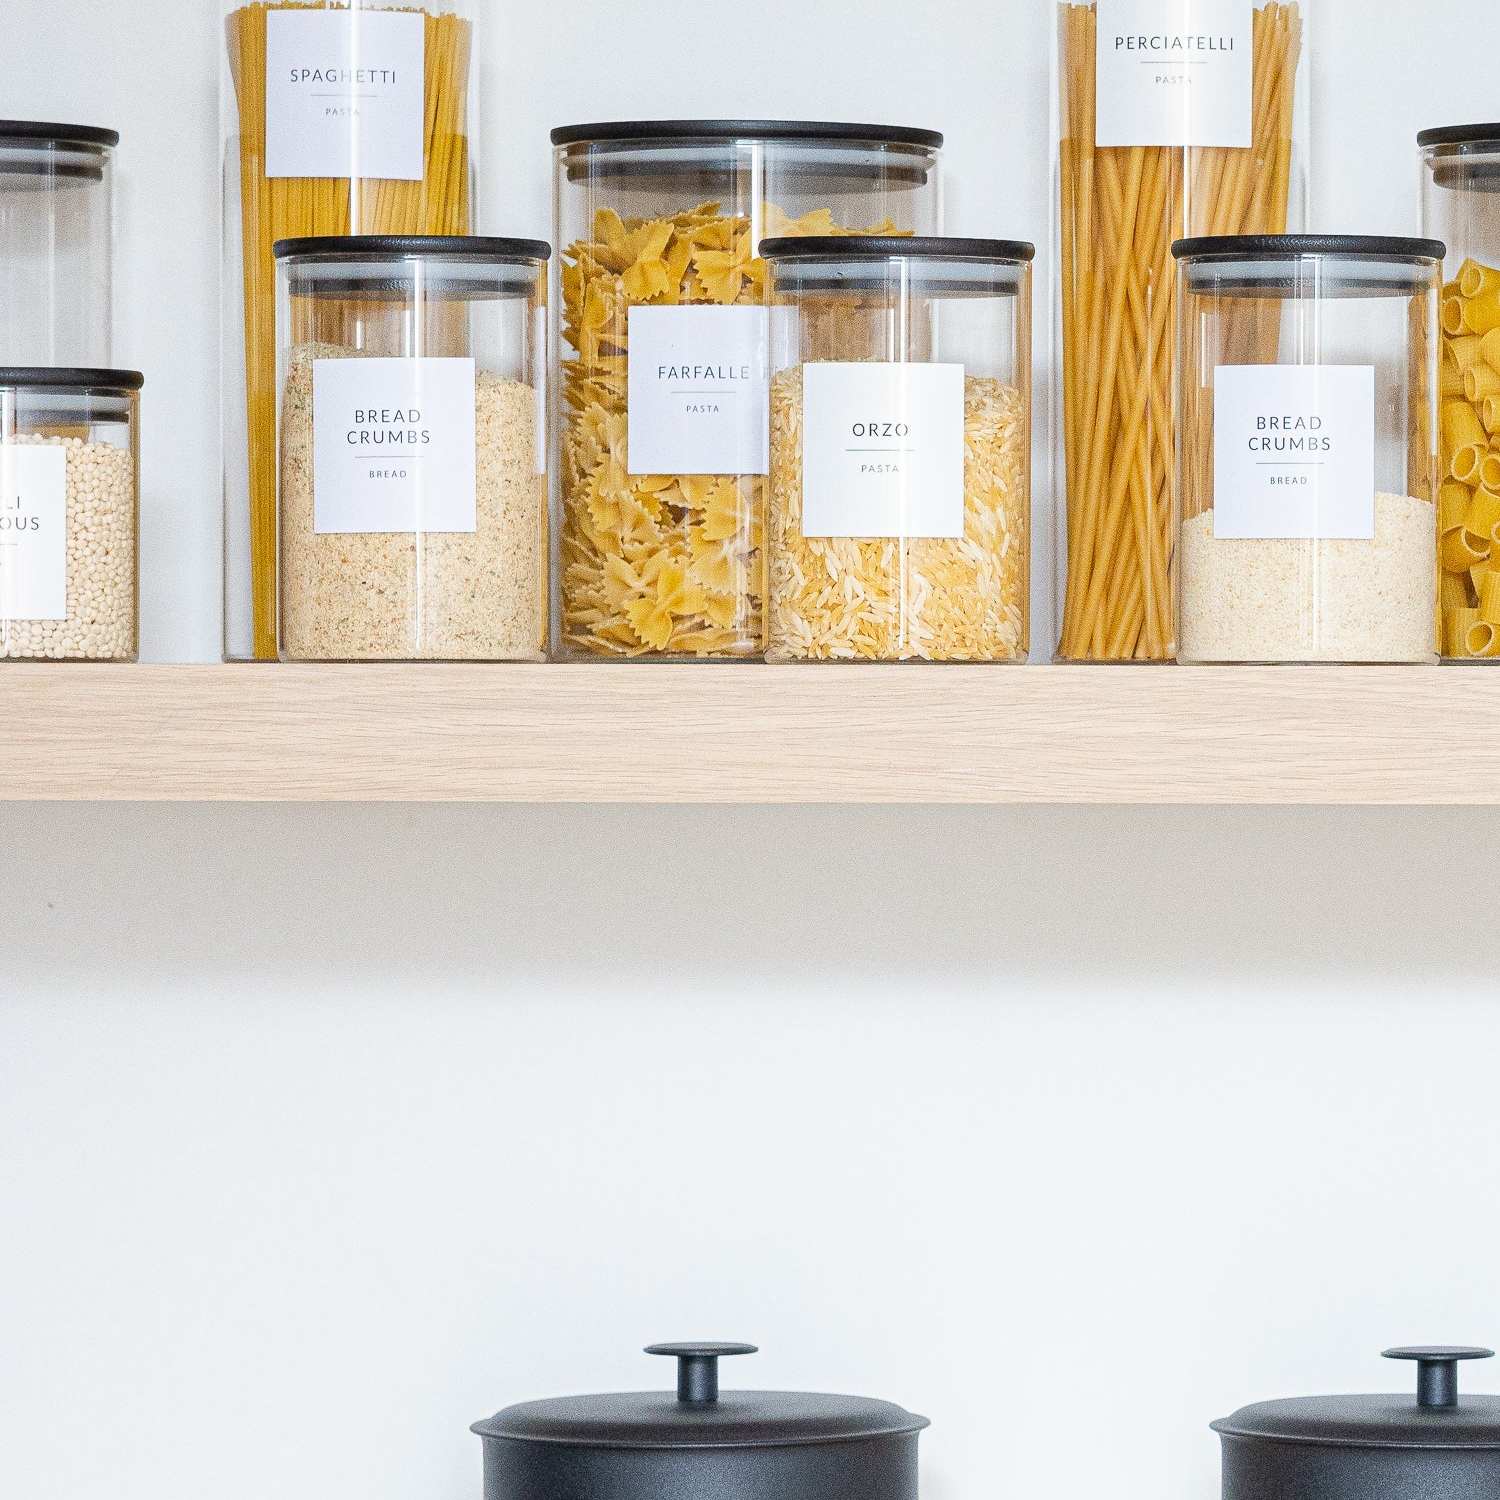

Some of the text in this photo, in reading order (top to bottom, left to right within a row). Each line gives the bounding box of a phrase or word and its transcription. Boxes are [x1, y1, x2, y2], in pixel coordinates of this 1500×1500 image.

[1115, 35, 1234, 52] PERCIATELLI
[289, 68, 396, 85] SPAGHETTI
[1155, 75, 1192, 85] PASTA
[325, 107, 360, 117] PASTA
[657, 364, 750, 381] FARFALLE
[354, 408, 421, 424] BREAD
[685, 404, 720, 414] PASTA
[850, 421, 909, 438] ORZO
[1256, 415, 1322, 431] BREAD
[345, 429, 430, 446] CRUMBS
[1247, 436, 1331, 453] CRUMBS
[368, 468, 407, 479] BREAD
[860, 464, 899, 474] PASTA
[1269, 476, 1308, 485] BREAD
